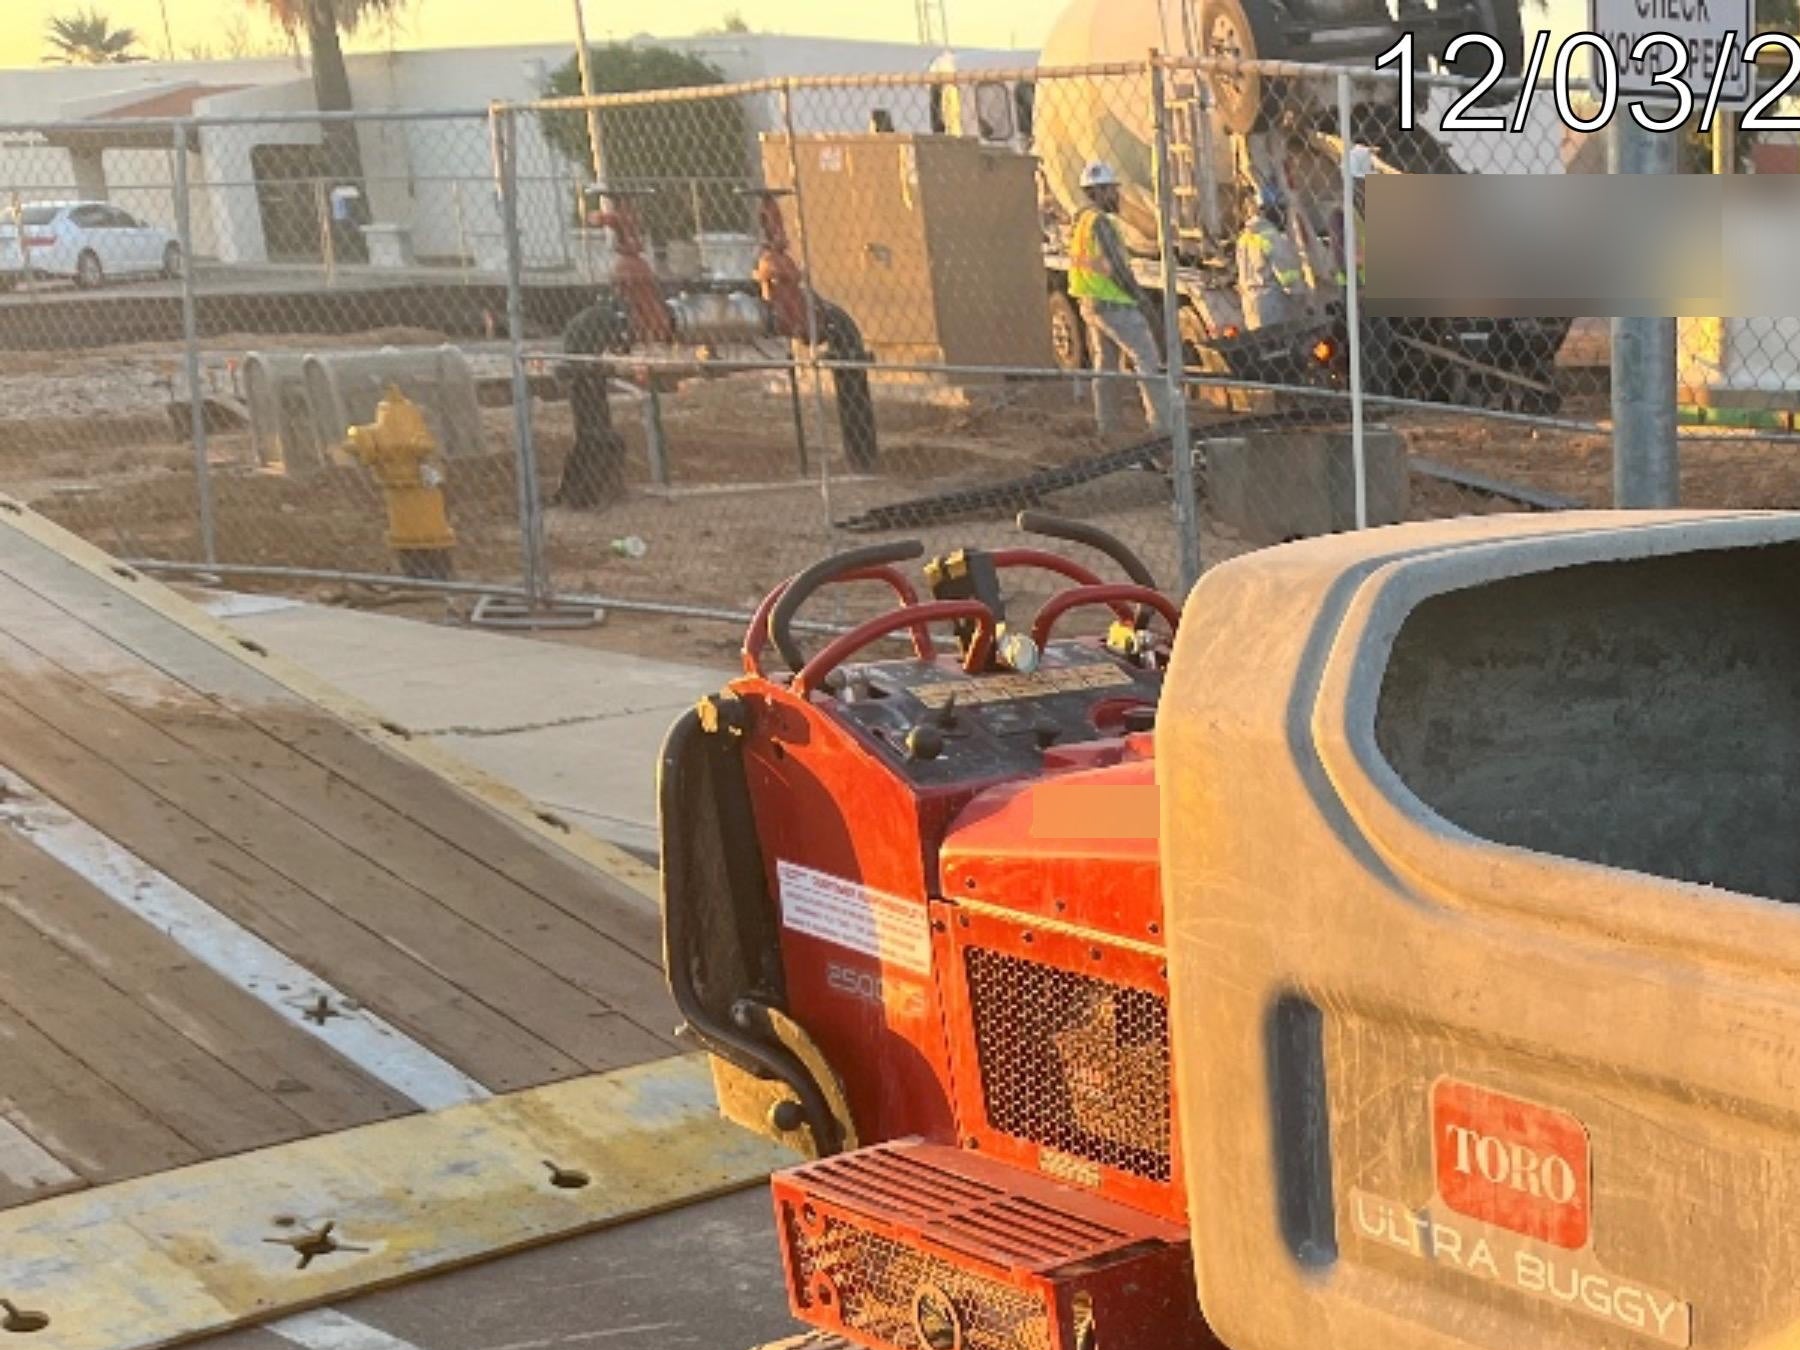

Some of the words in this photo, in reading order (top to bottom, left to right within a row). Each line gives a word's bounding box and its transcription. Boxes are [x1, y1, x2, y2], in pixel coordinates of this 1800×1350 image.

[1445, 1124, 1577, 1206] TORO
[1356, 1195, 1499, 1279] ULTRA
[1516, 1251, 1677, 1336] BUGGY
